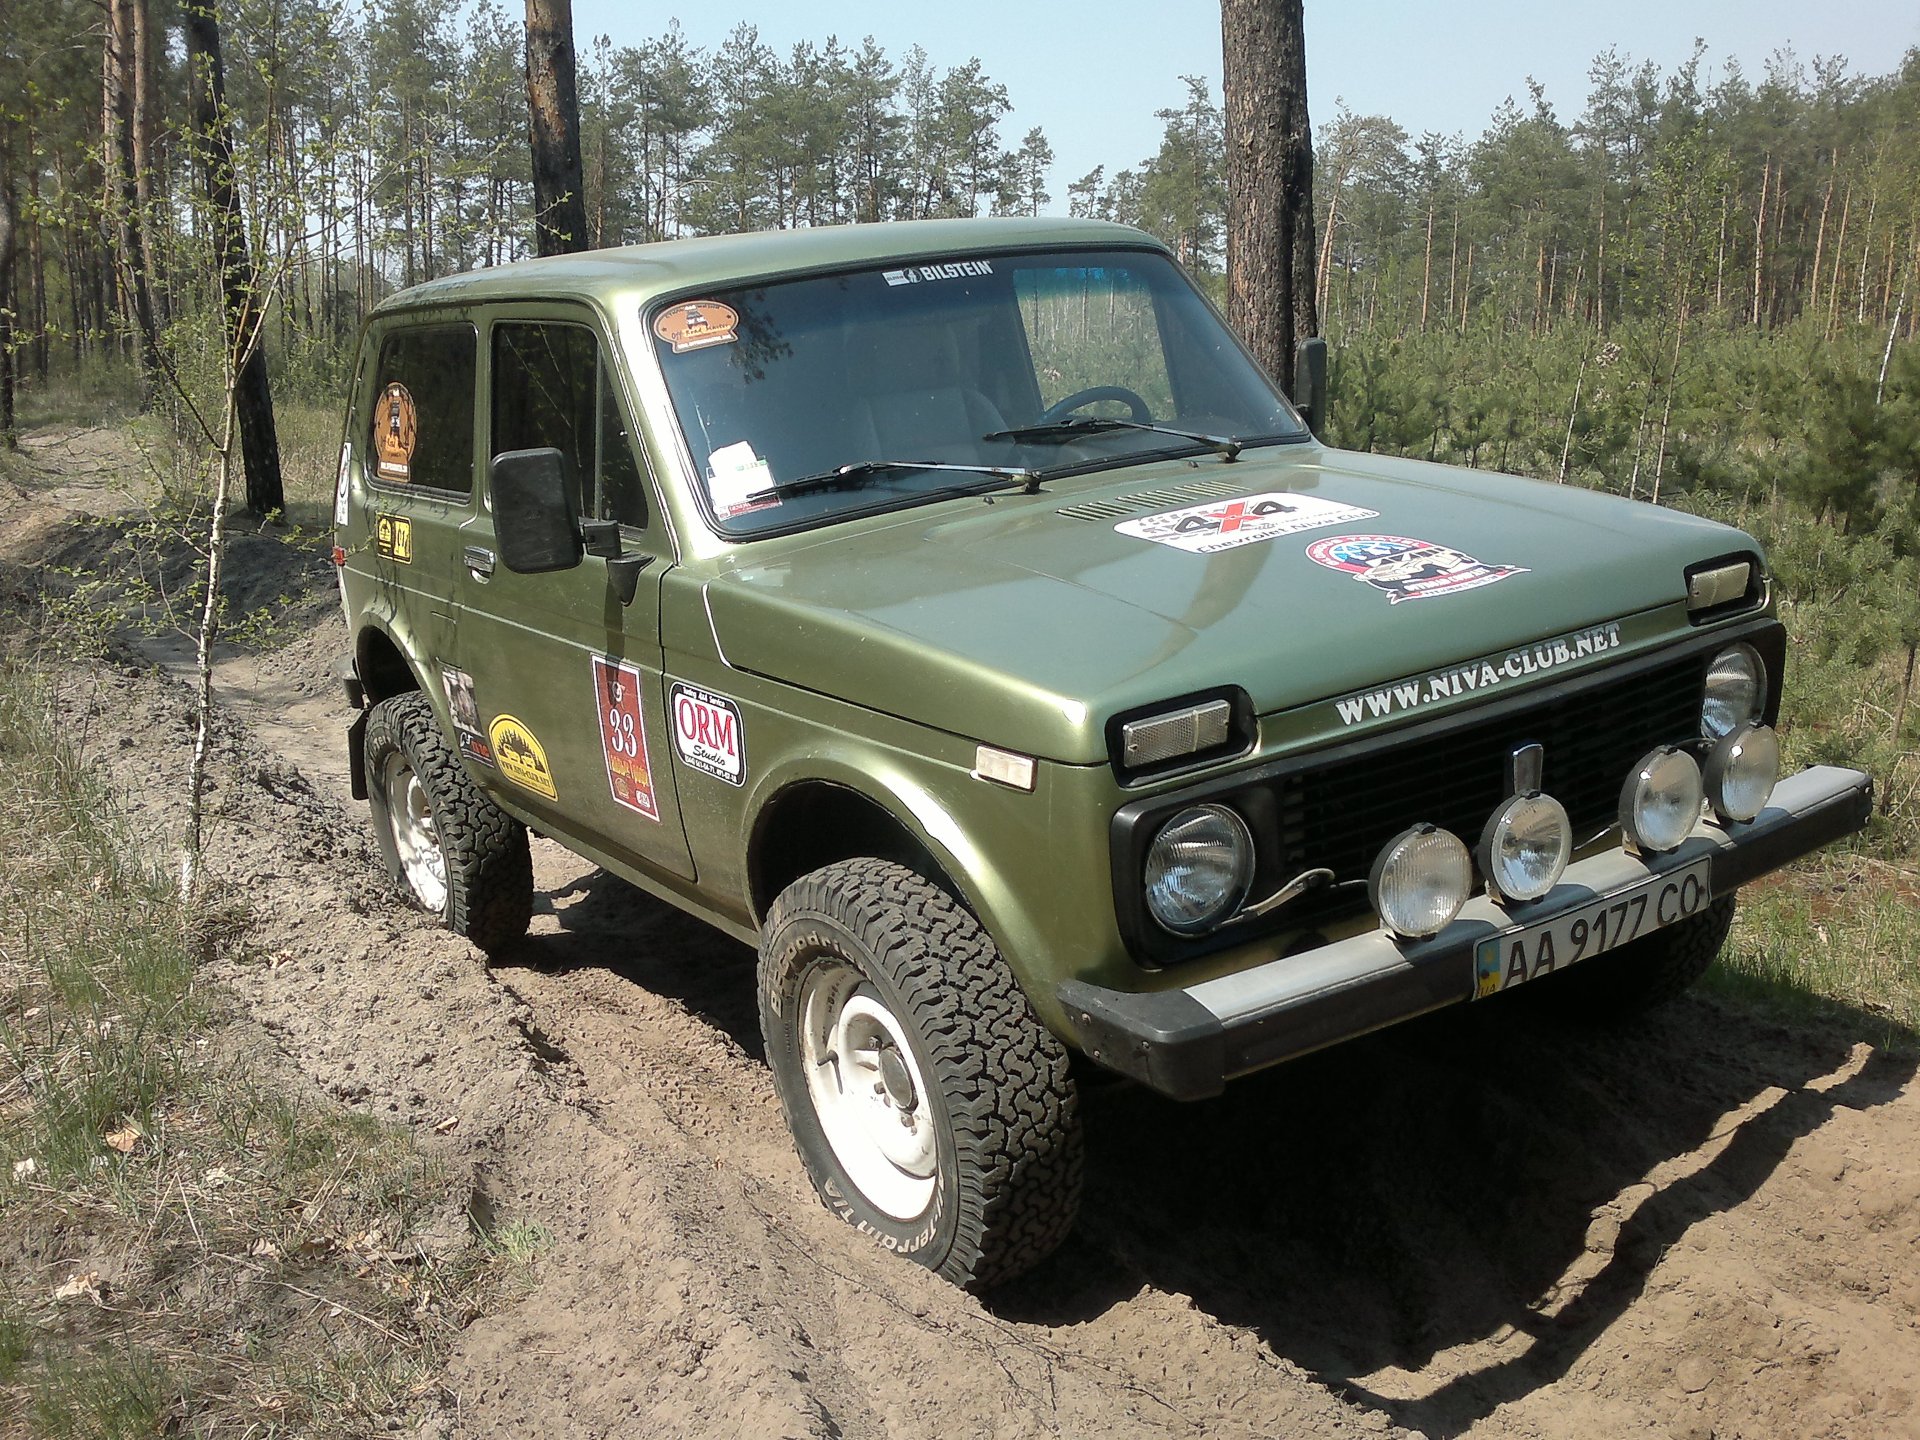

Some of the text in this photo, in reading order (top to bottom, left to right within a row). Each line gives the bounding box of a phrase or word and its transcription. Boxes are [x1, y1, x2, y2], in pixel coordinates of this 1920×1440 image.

[920, 260, 994, 281] BILSTEIN
[1196, 527, 1286, 554] Chevrolet
[1291, 519, 1333, 533] Niva
[1336, 509, 1377, 523] Club
[1335, 622, 1620, 727] WWW.NIVA-CLUB.NET
[609, 708, 638, 758] 33
[679, 698, 736, 757] ORM
[692, 744, 726, 767] Studio
[1502, 873, 1701, 988] AA 9177 CO
